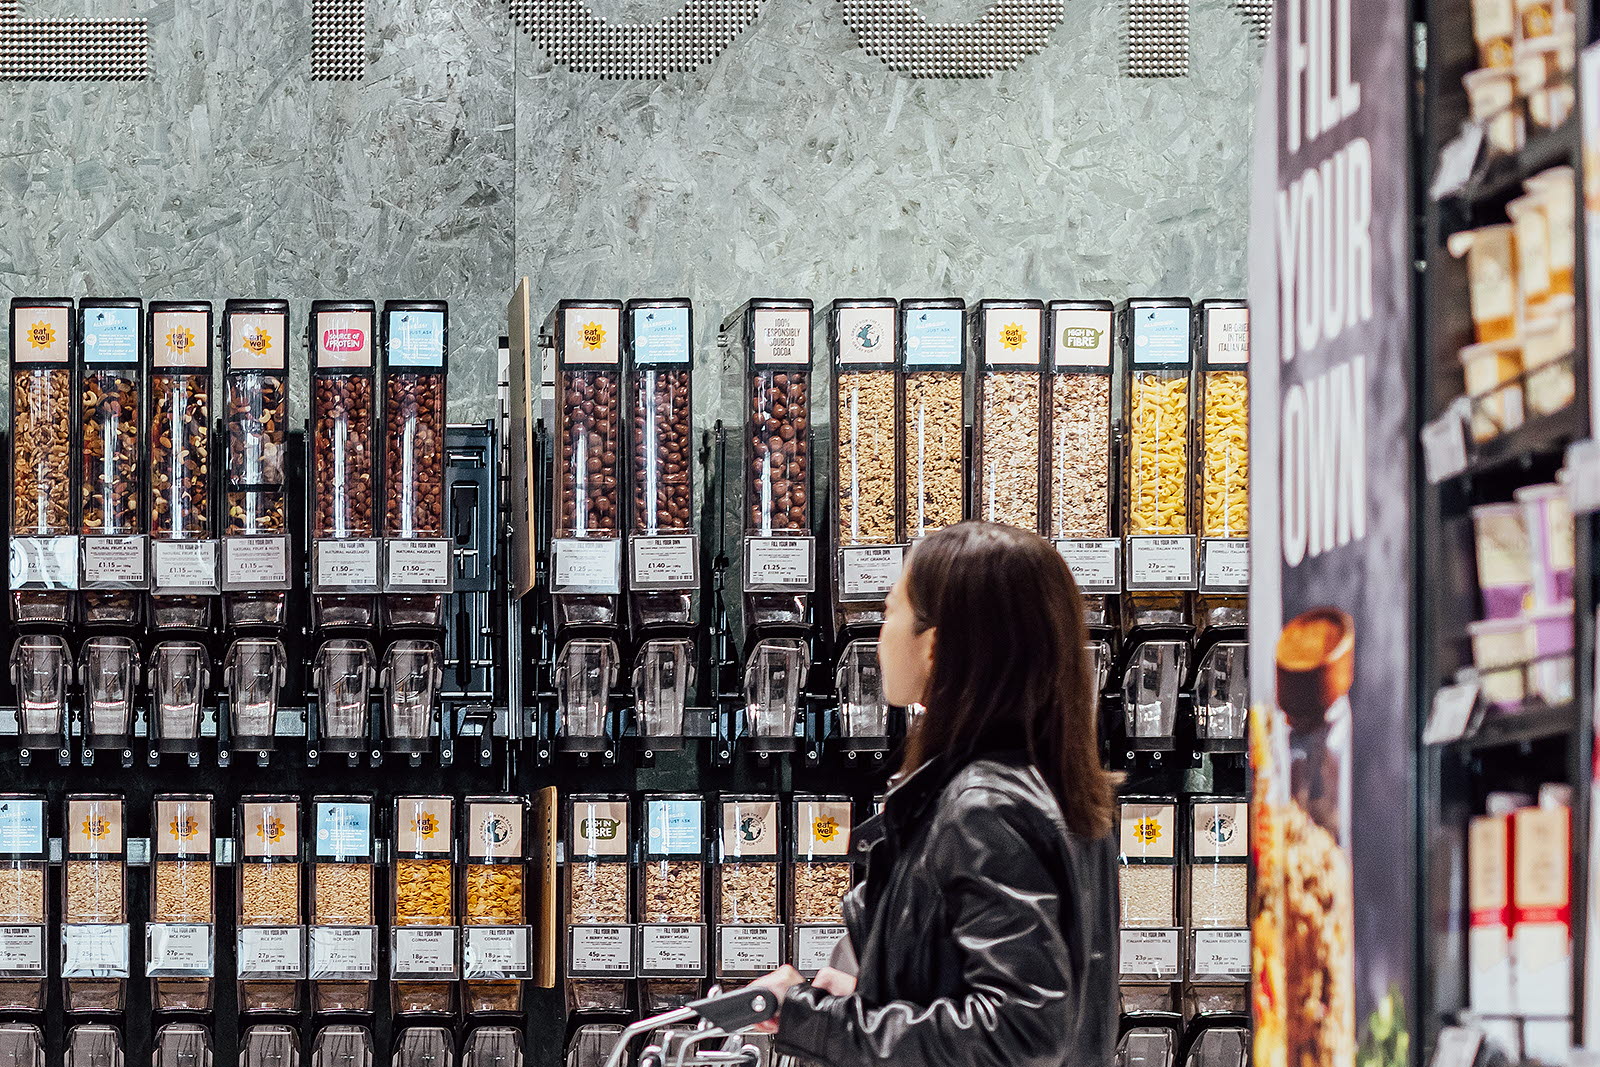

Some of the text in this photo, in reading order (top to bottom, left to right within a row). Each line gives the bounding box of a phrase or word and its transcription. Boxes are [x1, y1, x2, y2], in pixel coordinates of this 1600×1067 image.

[1287, 0, 1362, 154] FILL
[1276, 137, 1373, 363] YOUR
[584, 334, 600, 342] well
[1068, 337, 1095, 347] FIBRE
[772, 348, 791, 356] COCOA
[1284, 355, 1366, 567] OWN
[603, 820, 611, 828] IN
[817, 821, 830, 829] eat
